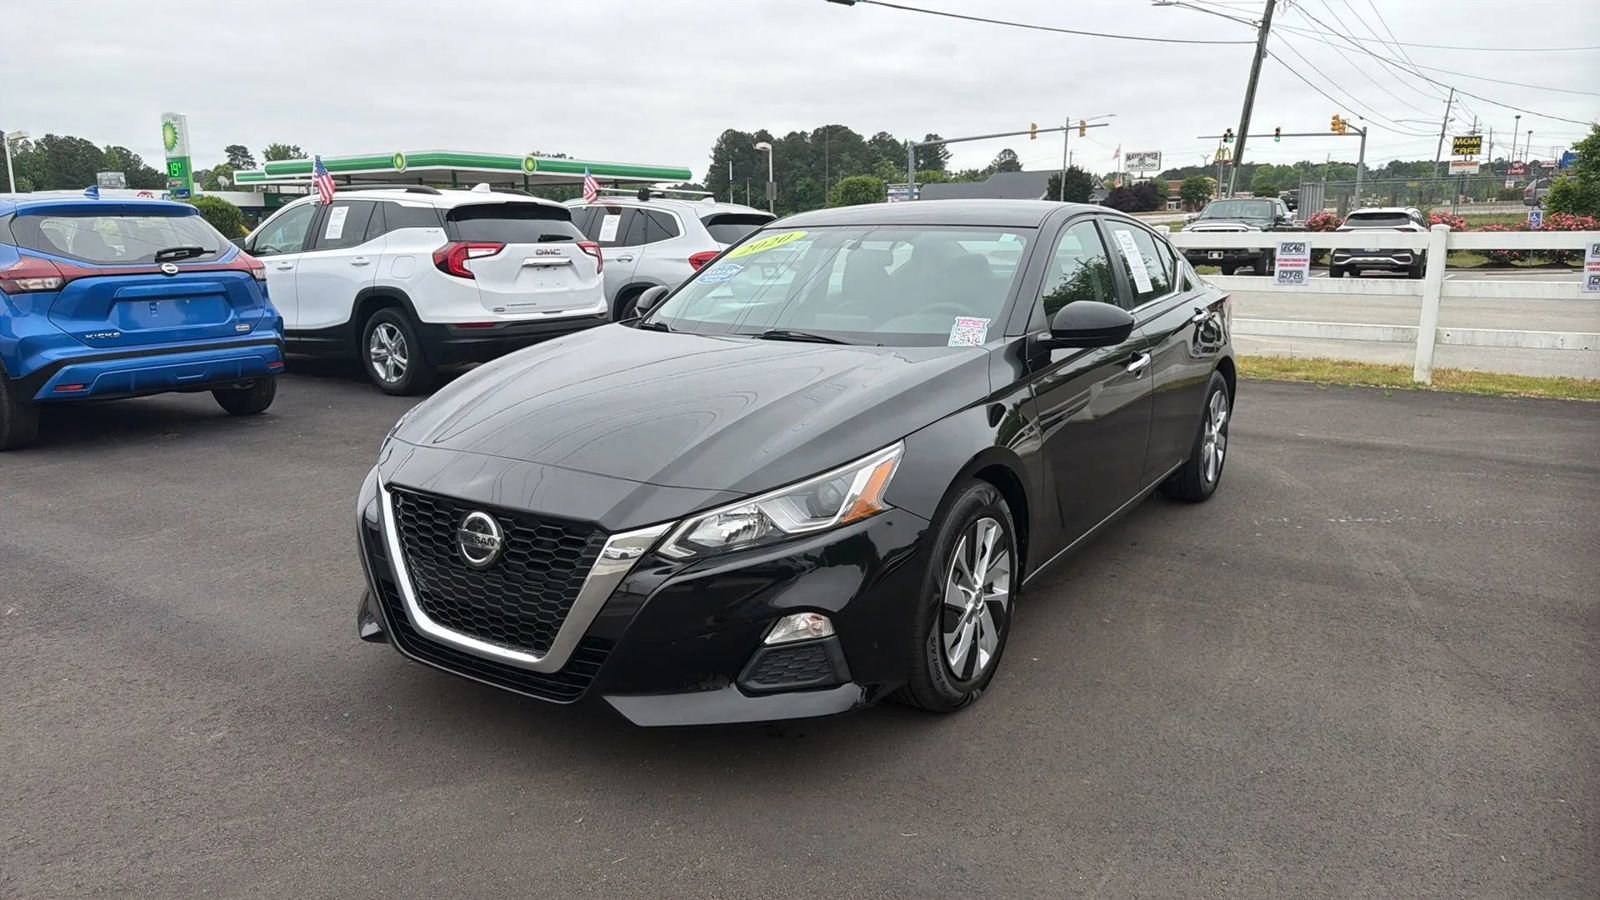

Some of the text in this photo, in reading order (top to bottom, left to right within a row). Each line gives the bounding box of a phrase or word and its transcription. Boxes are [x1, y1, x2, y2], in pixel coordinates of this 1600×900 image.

[1453, 147, 1481, 155] CAFE
[1126, 152, 1159, 161] MAYFLOWER
[738, 232, 796, 256] 2020
[535, 248, 561, 256] GMC
[85, 332, 120, 340] KICKS
[460, 532, 495, 547] NISSAN
